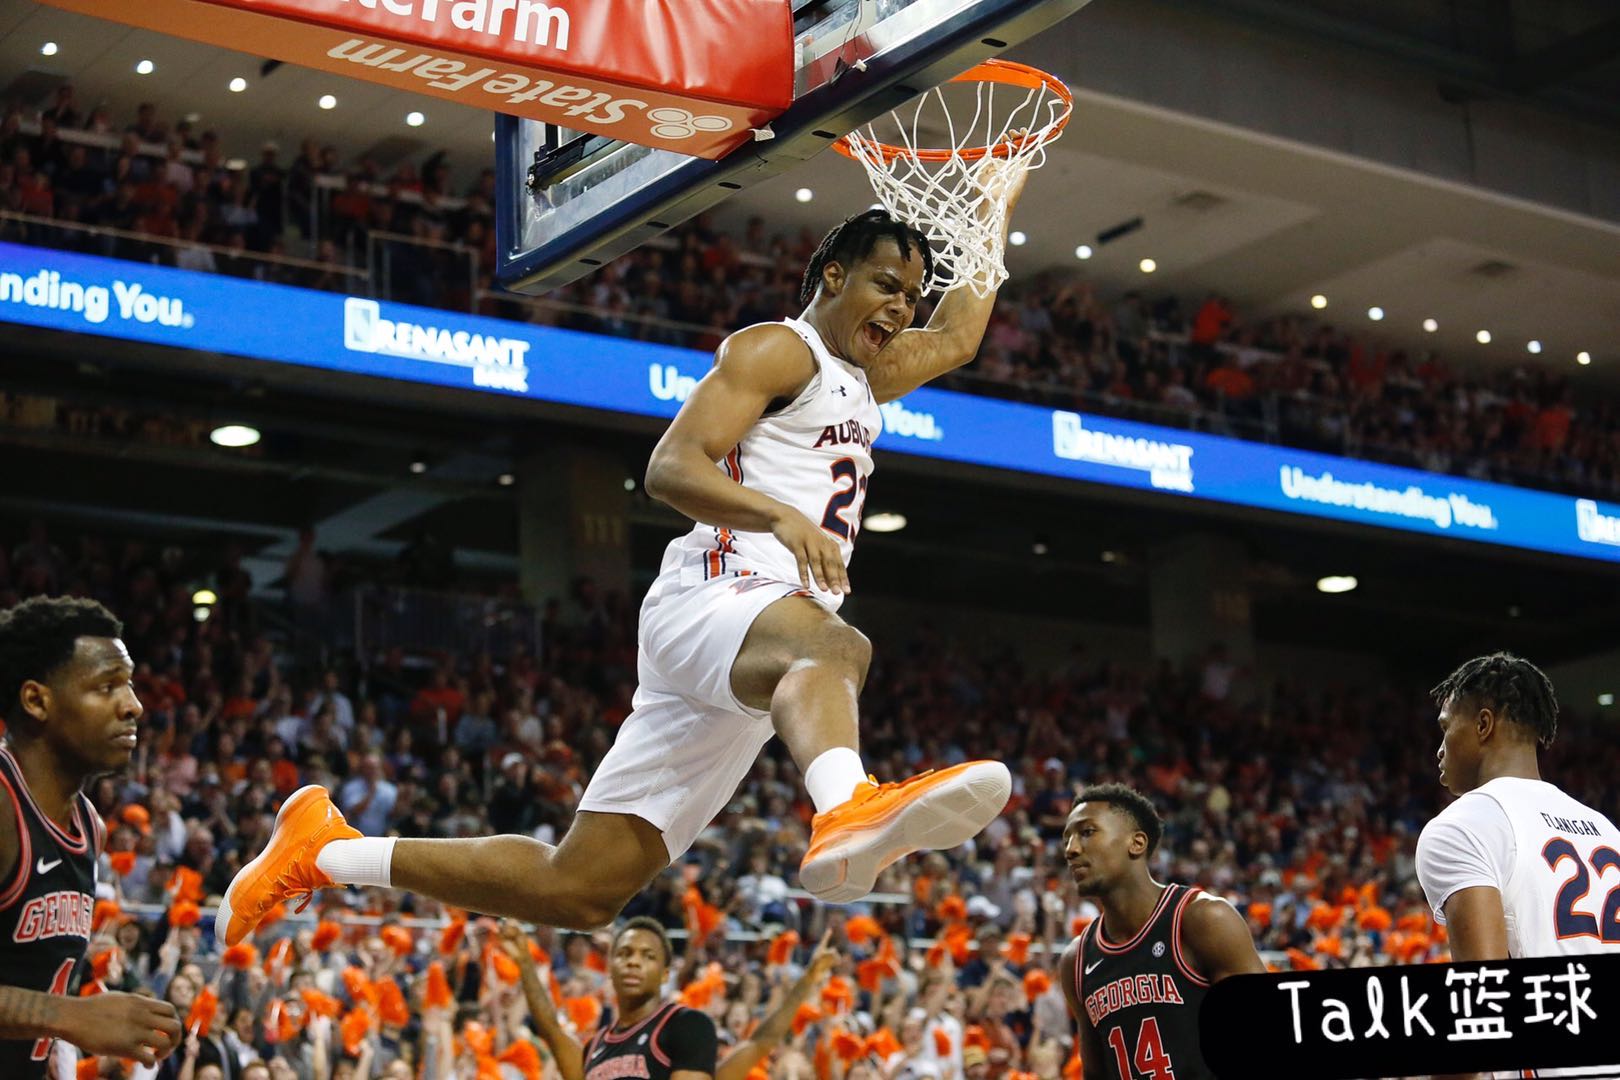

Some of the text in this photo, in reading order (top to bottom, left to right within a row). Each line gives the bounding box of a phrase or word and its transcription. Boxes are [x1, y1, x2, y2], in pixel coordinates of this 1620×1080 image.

[1280, 464, 1451, 528] Understanding
[1540, 811, 1602, 837] FLANIGAN
[1541, 836, 1620, 944] 22
[1085, 973, 1184, 1028] GEORGIA
[1108, 1016, 1176, 1080] 14
